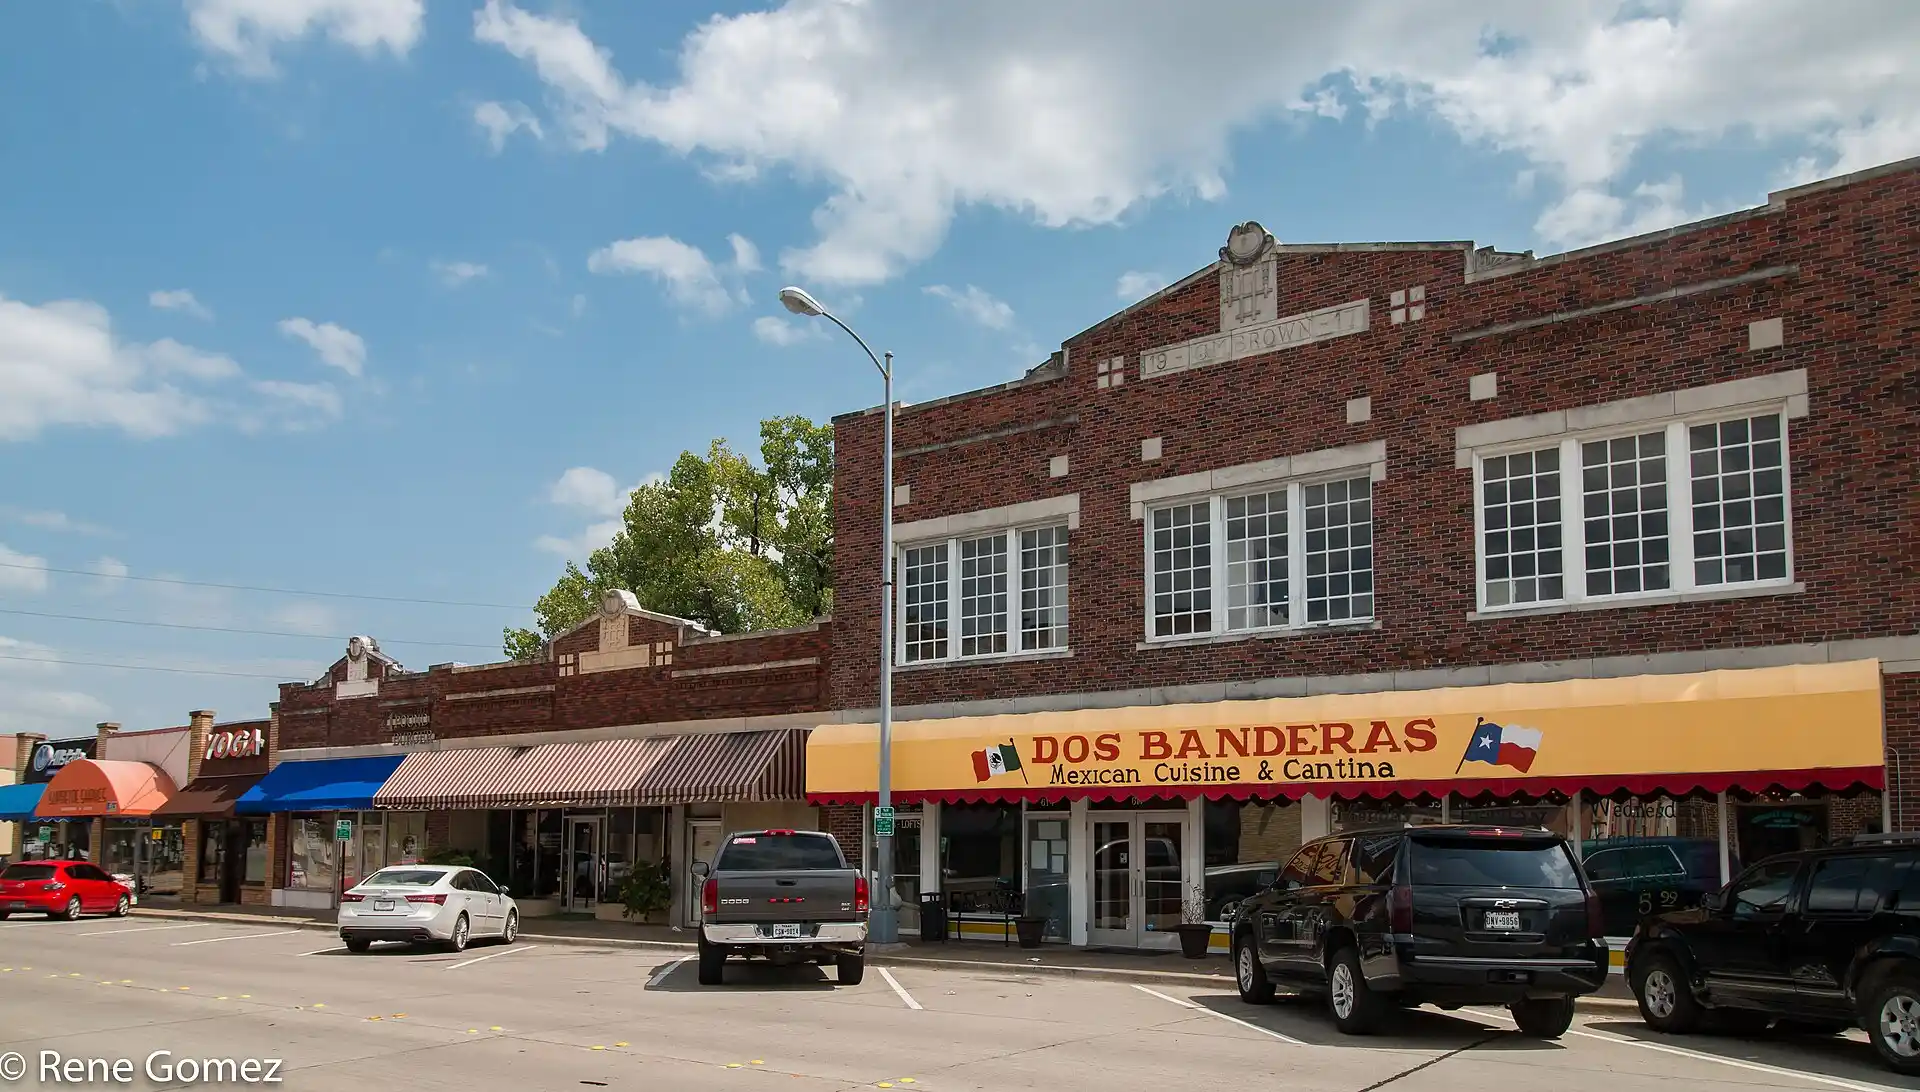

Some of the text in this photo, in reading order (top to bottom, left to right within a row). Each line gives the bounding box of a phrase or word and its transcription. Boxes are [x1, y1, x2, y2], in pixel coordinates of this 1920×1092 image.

[1234, 317, 1312, 352] BROWN
[205, 728, 264, 760] YOGA
[1031, 717, 1438, 764] DOS BANDERAS
[1050, 757, 1396, 785] Mexican Cuisine & Cantina
[901, 819, 921, 829] LOFTS
